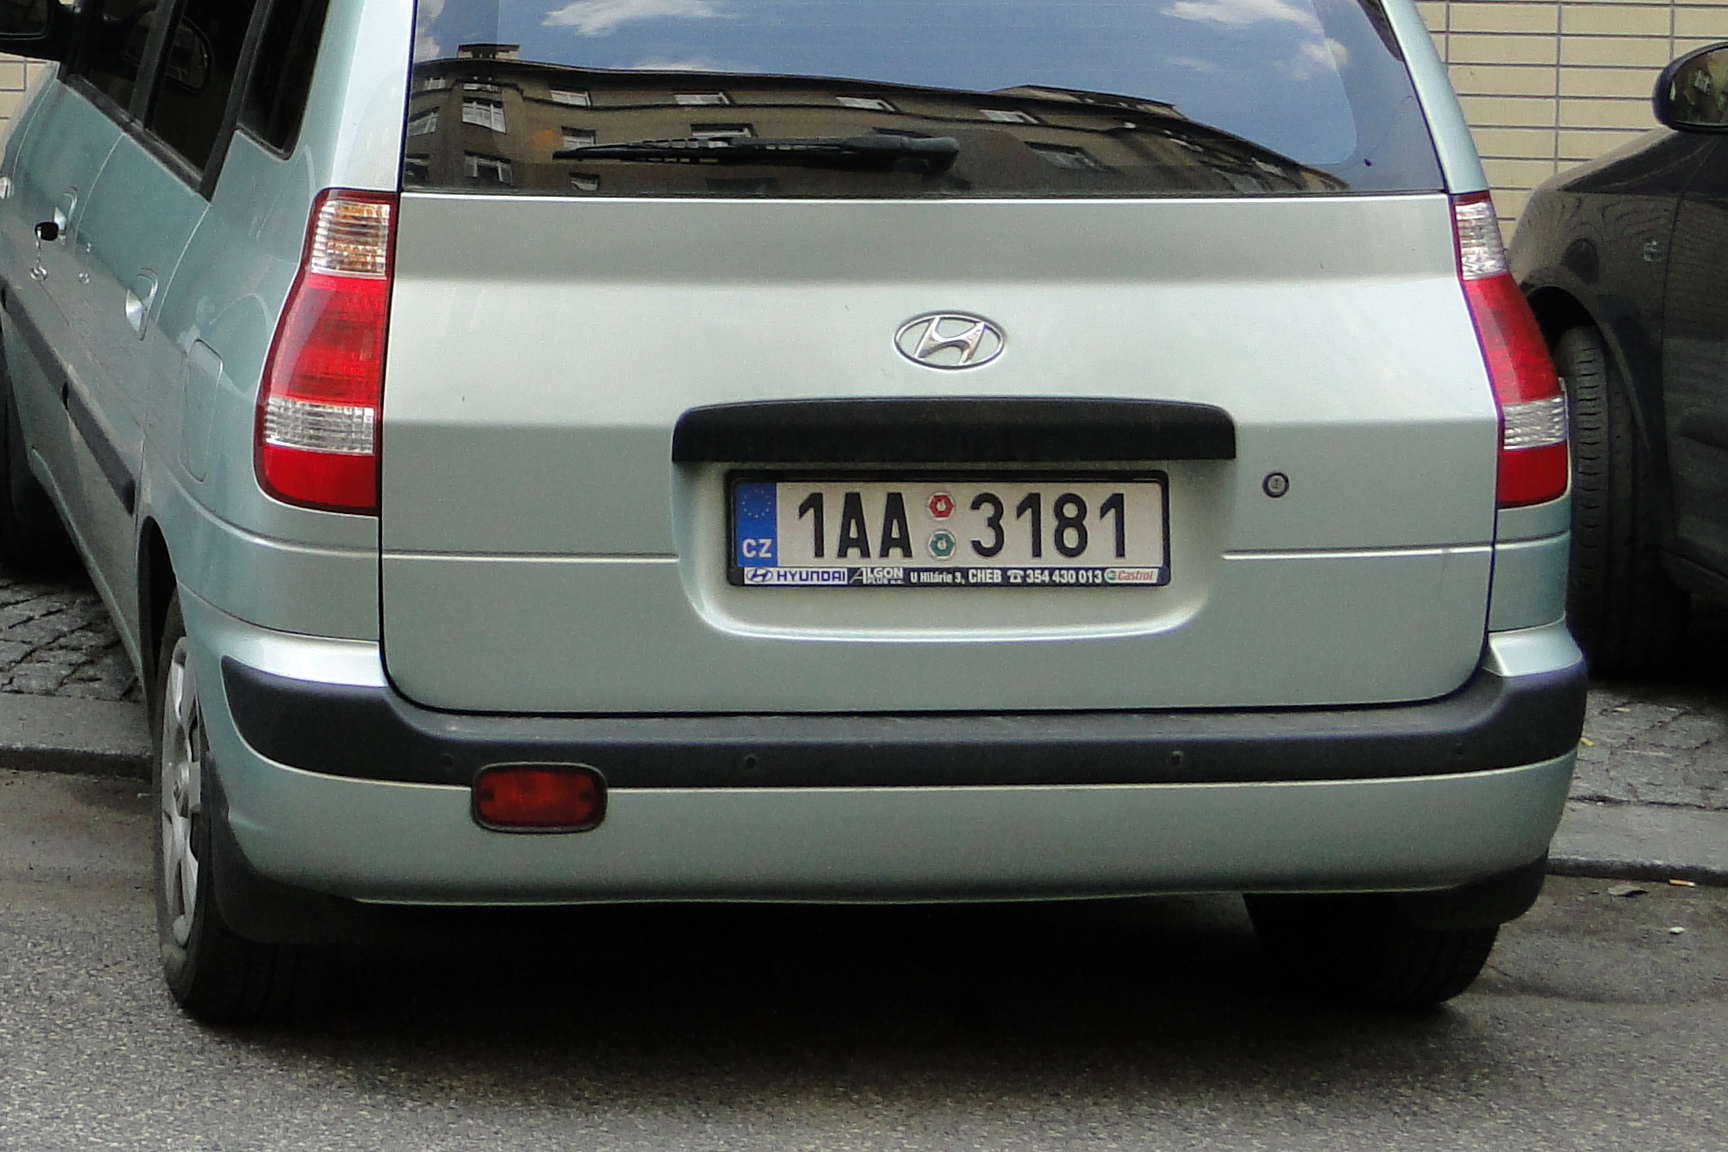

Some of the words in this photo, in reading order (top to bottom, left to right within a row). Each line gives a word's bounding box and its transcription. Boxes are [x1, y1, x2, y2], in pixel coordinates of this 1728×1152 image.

[743, 538, 773, 559] CZ
[798, 491, 913, 559] 1AA
[969, 491, 1126, 559] 3181
[777, 570, 846, 582] HYUNDAI
[849, 567, 904, 584] ALGON
[910, 571, 916, 583] U
[921, 571, 953, 583] Hilárie
[955, 572, 965, 584] 3,
[969, 570, 1002, 583] CHEB
[1026, 570, 1049, 583] 354
[1052, 570, 1076, 583] 430
[1079, 570, 1102, 583] 013
[1117, 569, 1154, 581] Castrol
